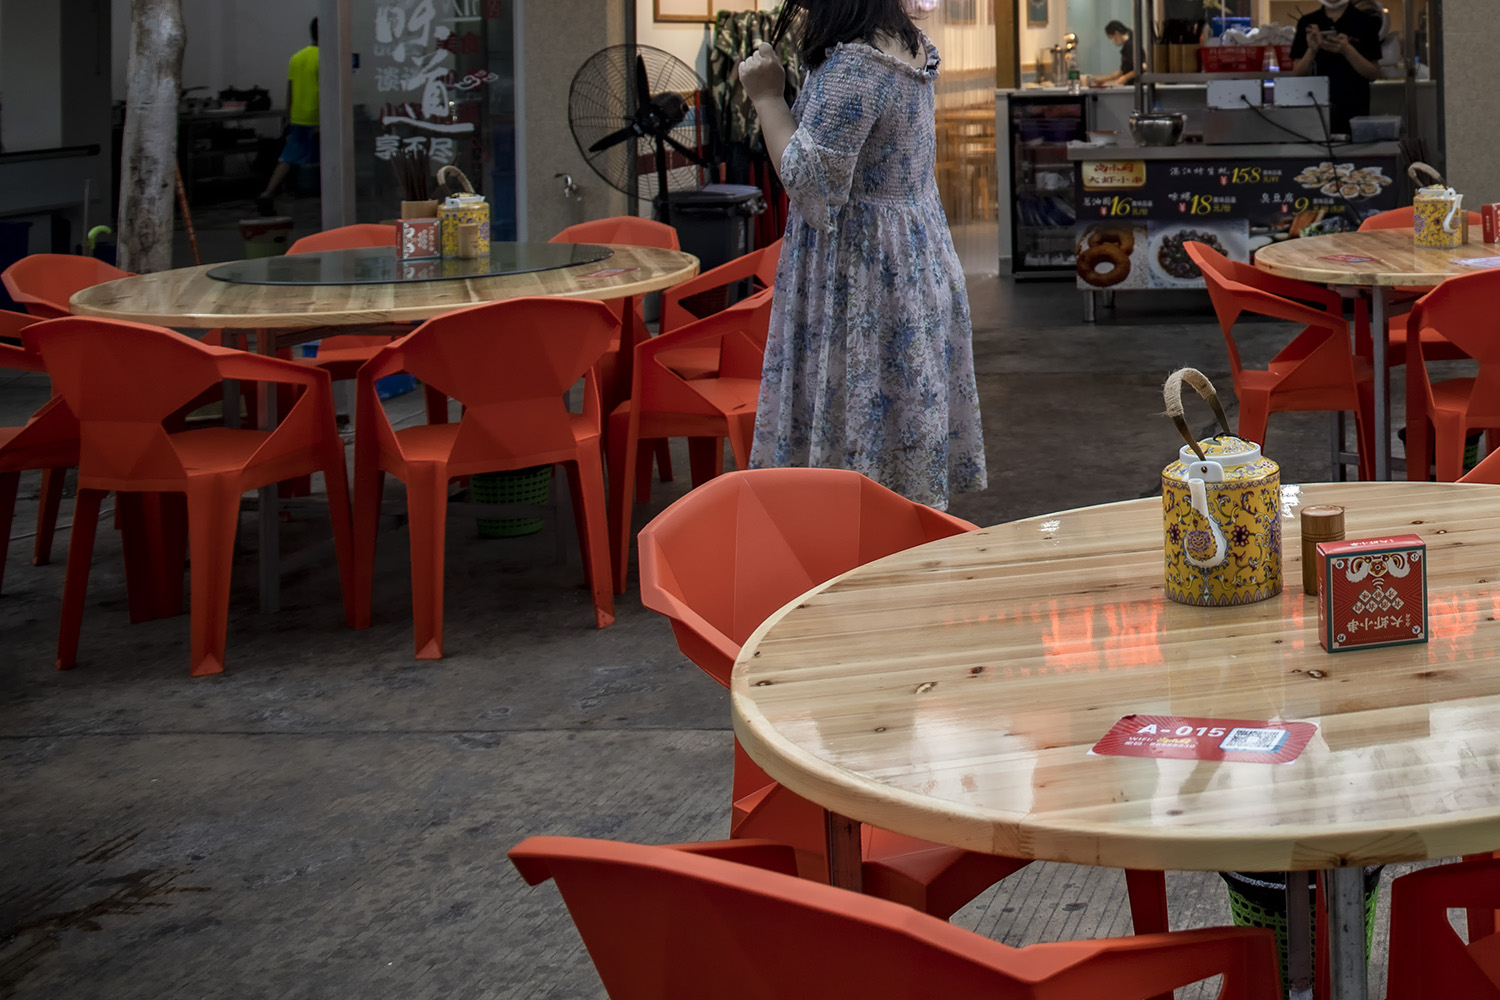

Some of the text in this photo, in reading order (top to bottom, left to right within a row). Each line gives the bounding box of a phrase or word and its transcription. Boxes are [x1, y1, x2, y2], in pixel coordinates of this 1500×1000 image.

[1231, 166, 1262, 184] 158
[1110, 195, 1134, 217] 16
[1190, 194, 1213, 215] 18
[1259, 192, 1294, 204] 臭豆腐
[1292, 197, 1310, 215] 9
[1346, 614, 1403, 633] 大虾小串
[1137, 723, 1227, 738] A-015
